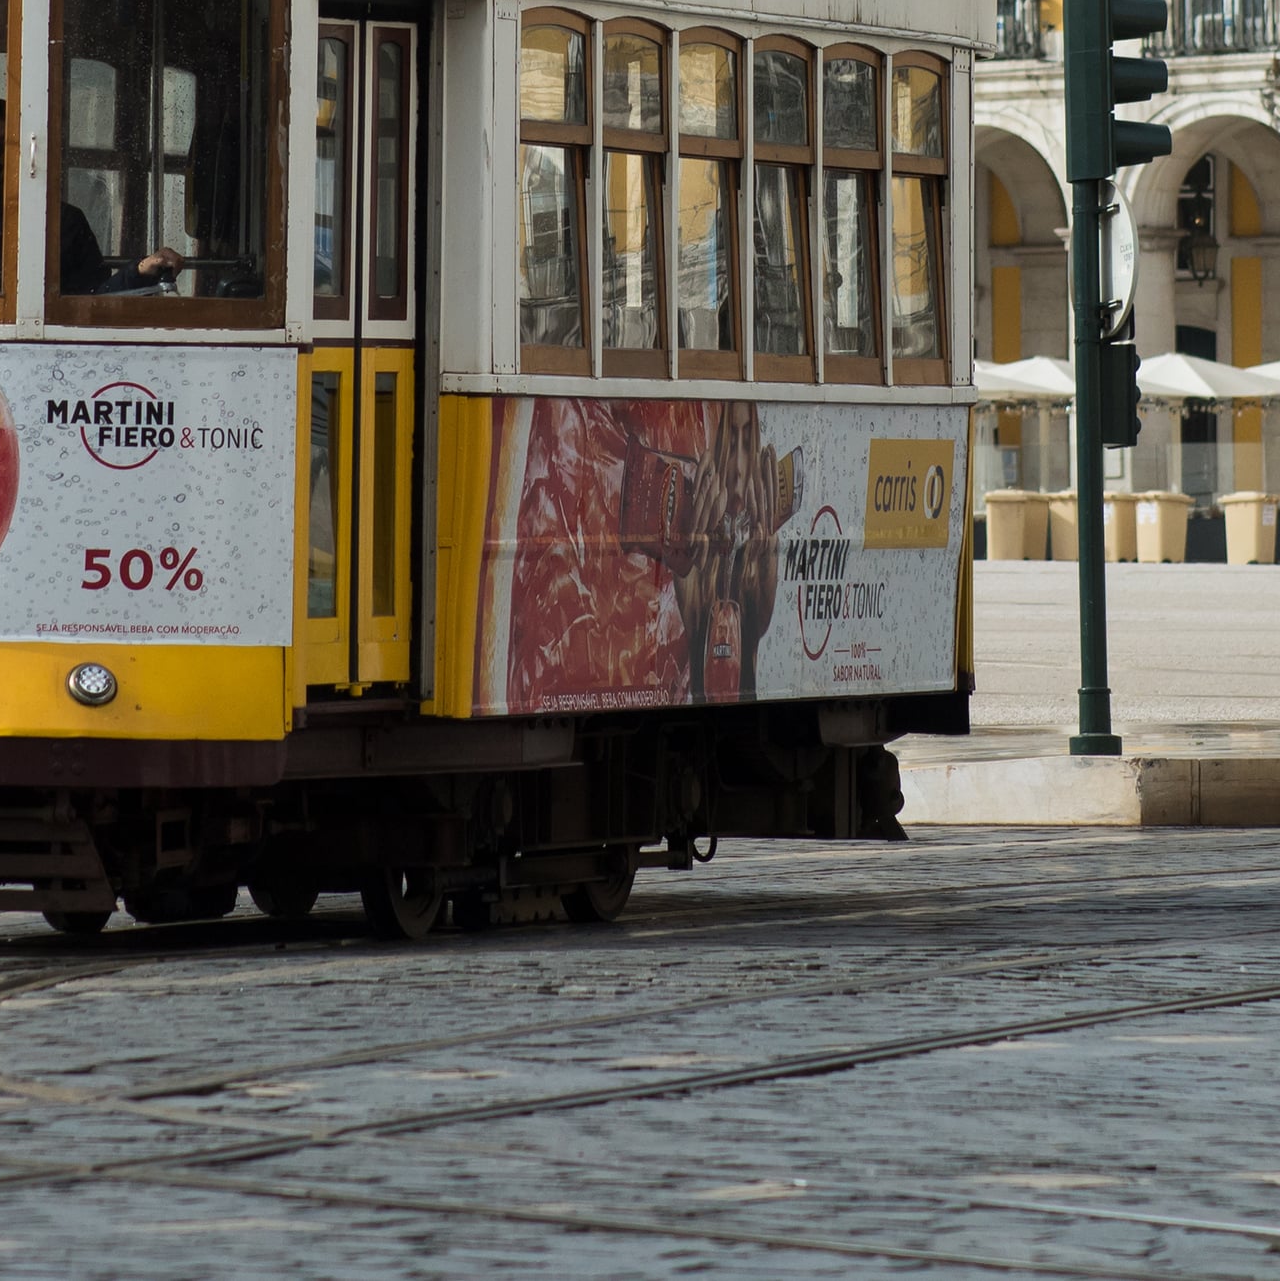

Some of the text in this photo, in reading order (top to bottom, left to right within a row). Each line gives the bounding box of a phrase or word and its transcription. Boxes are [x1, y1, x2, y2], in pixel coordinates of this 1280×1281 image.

[47, 399, 175, 425] MARTINI
[98, 426, 175, 448] FIERO
[874, 460, 917, 512] carris
[81, 547, 203, 591] 50%
[784, 538, 851, 581] MARTINI
[804, 584, 842, 620] FIERO
[36, 623, 59, 632] SEJA
[157, 625, 179, 634] COM
[181, 624, 242, 636] MODERAÇÃO.
[850, 642, 866, 659] 100%
[833, 665, 882, 682] SABOR NATURAL
[543, 695, 559, 712] SEJA
[601, 692, 618, 709] BEBA
[618, 692, 632, 708] COM
